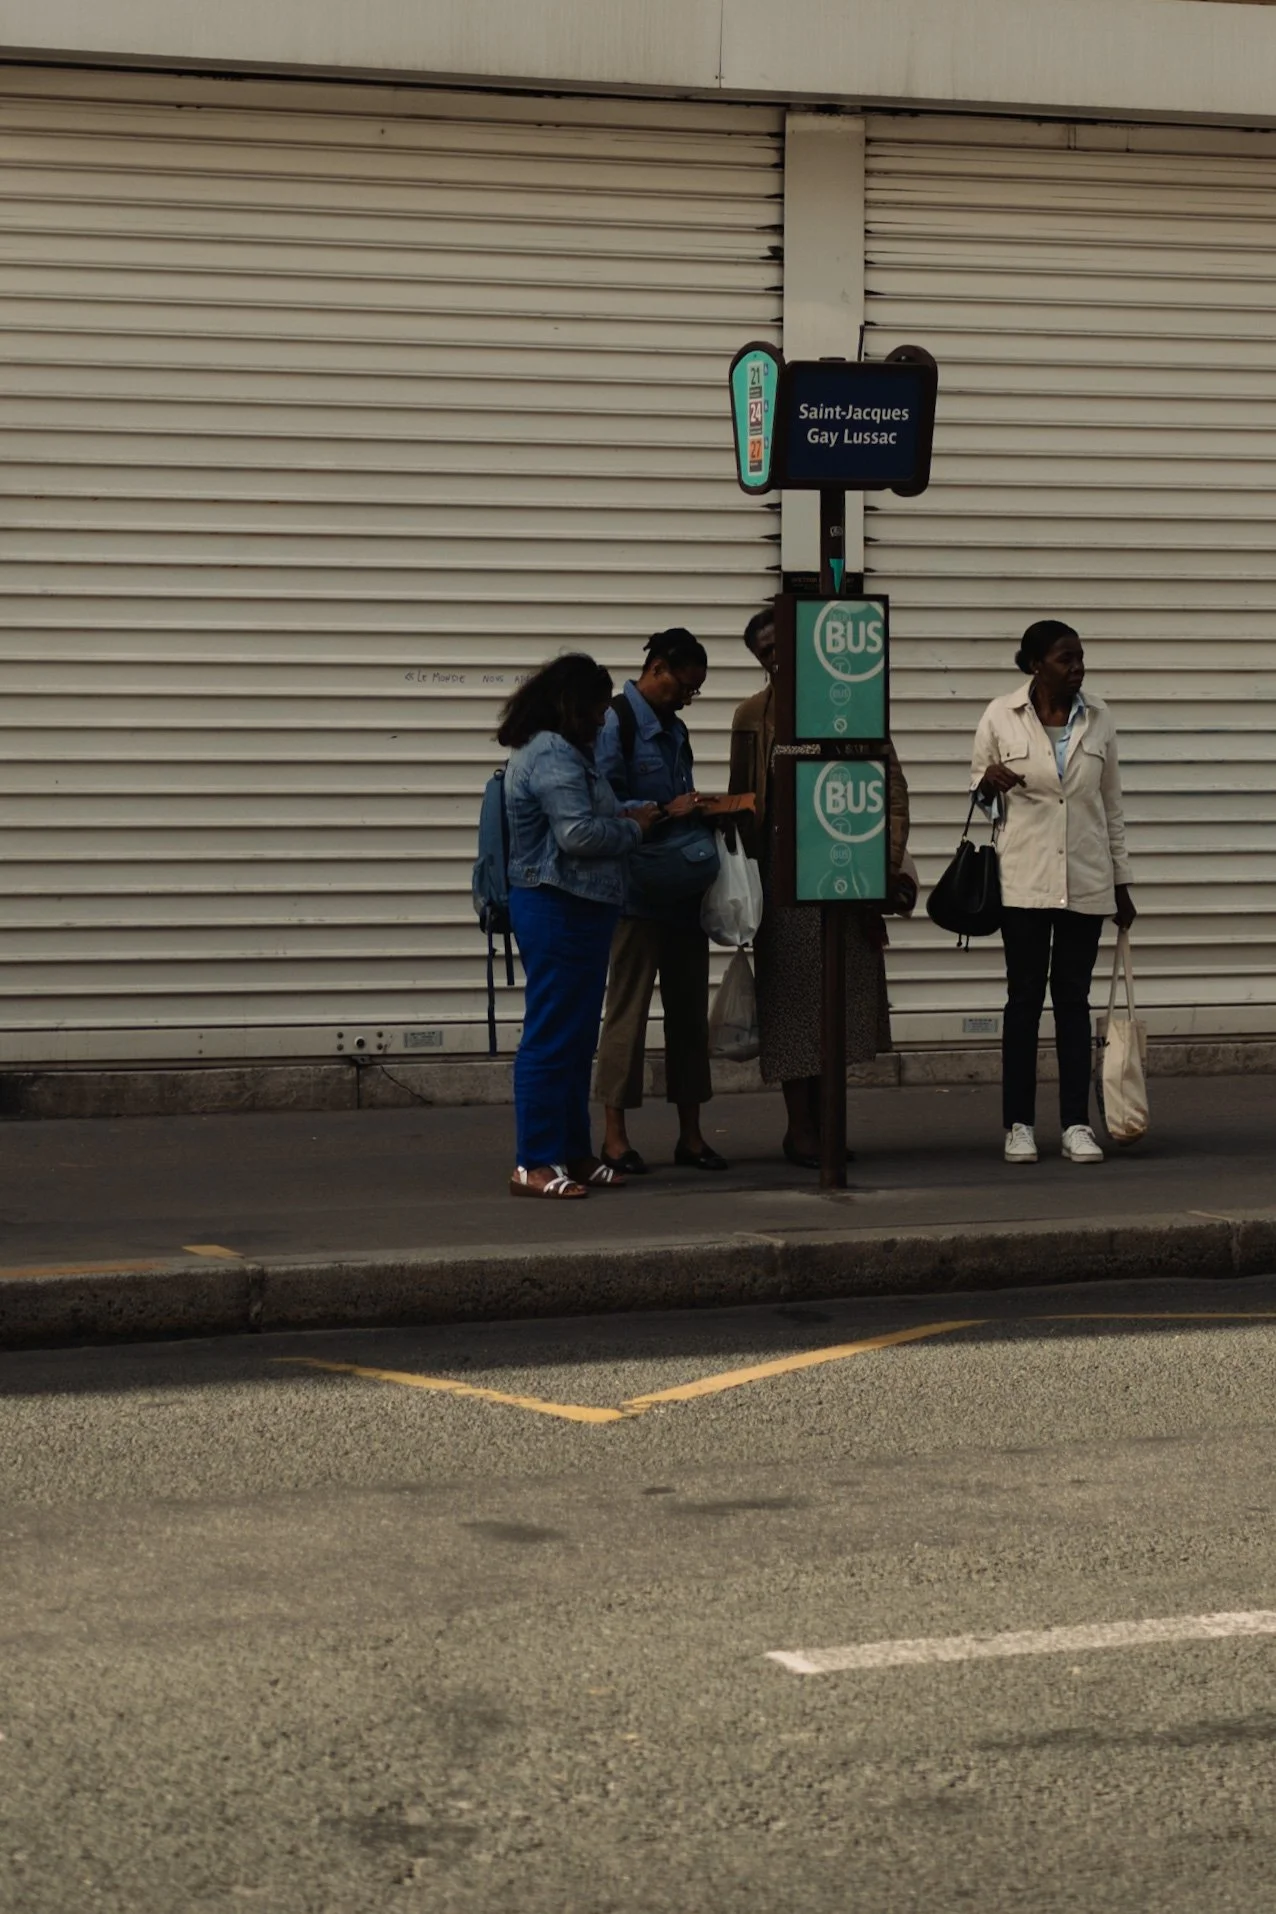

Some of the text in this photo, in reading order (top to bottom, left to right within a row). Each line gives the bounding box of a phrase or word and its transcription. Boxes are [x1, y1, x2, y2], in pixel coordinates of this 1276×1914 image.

[750, 367, 761, 385] 21
[750, 401, 762, 423] 24
[798, 403, 909, 424] Saint-Jacques
[807, 428, 897, 447] Gay Lussac
[750, 441, 761, 459] 27
[825, 620, 883, 654] BUS
[825, 780, 883, 814] BUS
